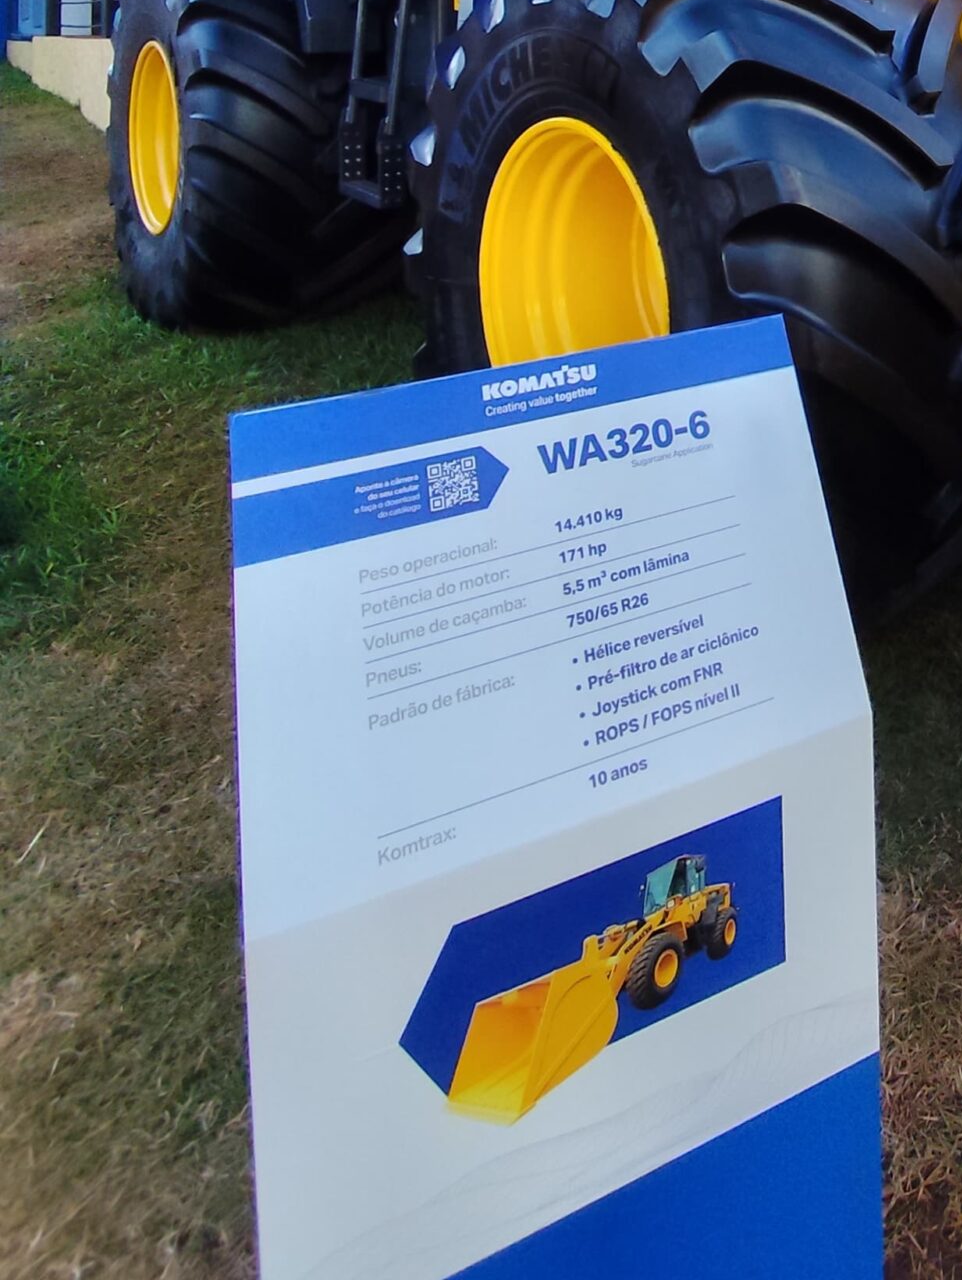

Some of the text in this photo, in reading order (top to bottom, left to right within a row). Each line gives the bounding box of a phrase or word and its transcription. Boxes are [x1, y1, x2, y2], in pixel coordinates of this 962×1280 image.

[481, 363, 597, 401] KOMATSU
[485, 386, 598, 417] Creating value together
[536, 410, 710, 474] WA320-6
[554, 508, 624, 533] 14.410 kg
[359, 538, 498, 584] Peso operacional:
[559, 543, 607, 564] 171 hp
[563, 578, 585, 596] 5,5
[610, 565, 641, 582] com
[643, 551, 690, 573] lâmina
[361, 569, 511, 617] Potência do motor:
[566, 593, 650, 628] 750/65 R26
[362, 597, 528, 651] Volume de caçamba:
[583, 614, 705, 664] Hélice reversível
[365, 661, 423, 688] Pneus:
[587, 625, 760, 690] Pré-filtro de ar ciclônico
[368, 675, 516, 731] Padrão de fábrica:
[592, 662, 724, 718] Joystick com FNR
[595, 718, 640, 745] ROPS
[651, 700, 693, 726] FOPS
[695, 687, 729, 711] nível
[588, 758, 648, 789] 10 anos
[377, 827, 456, 867] Komtrax:
